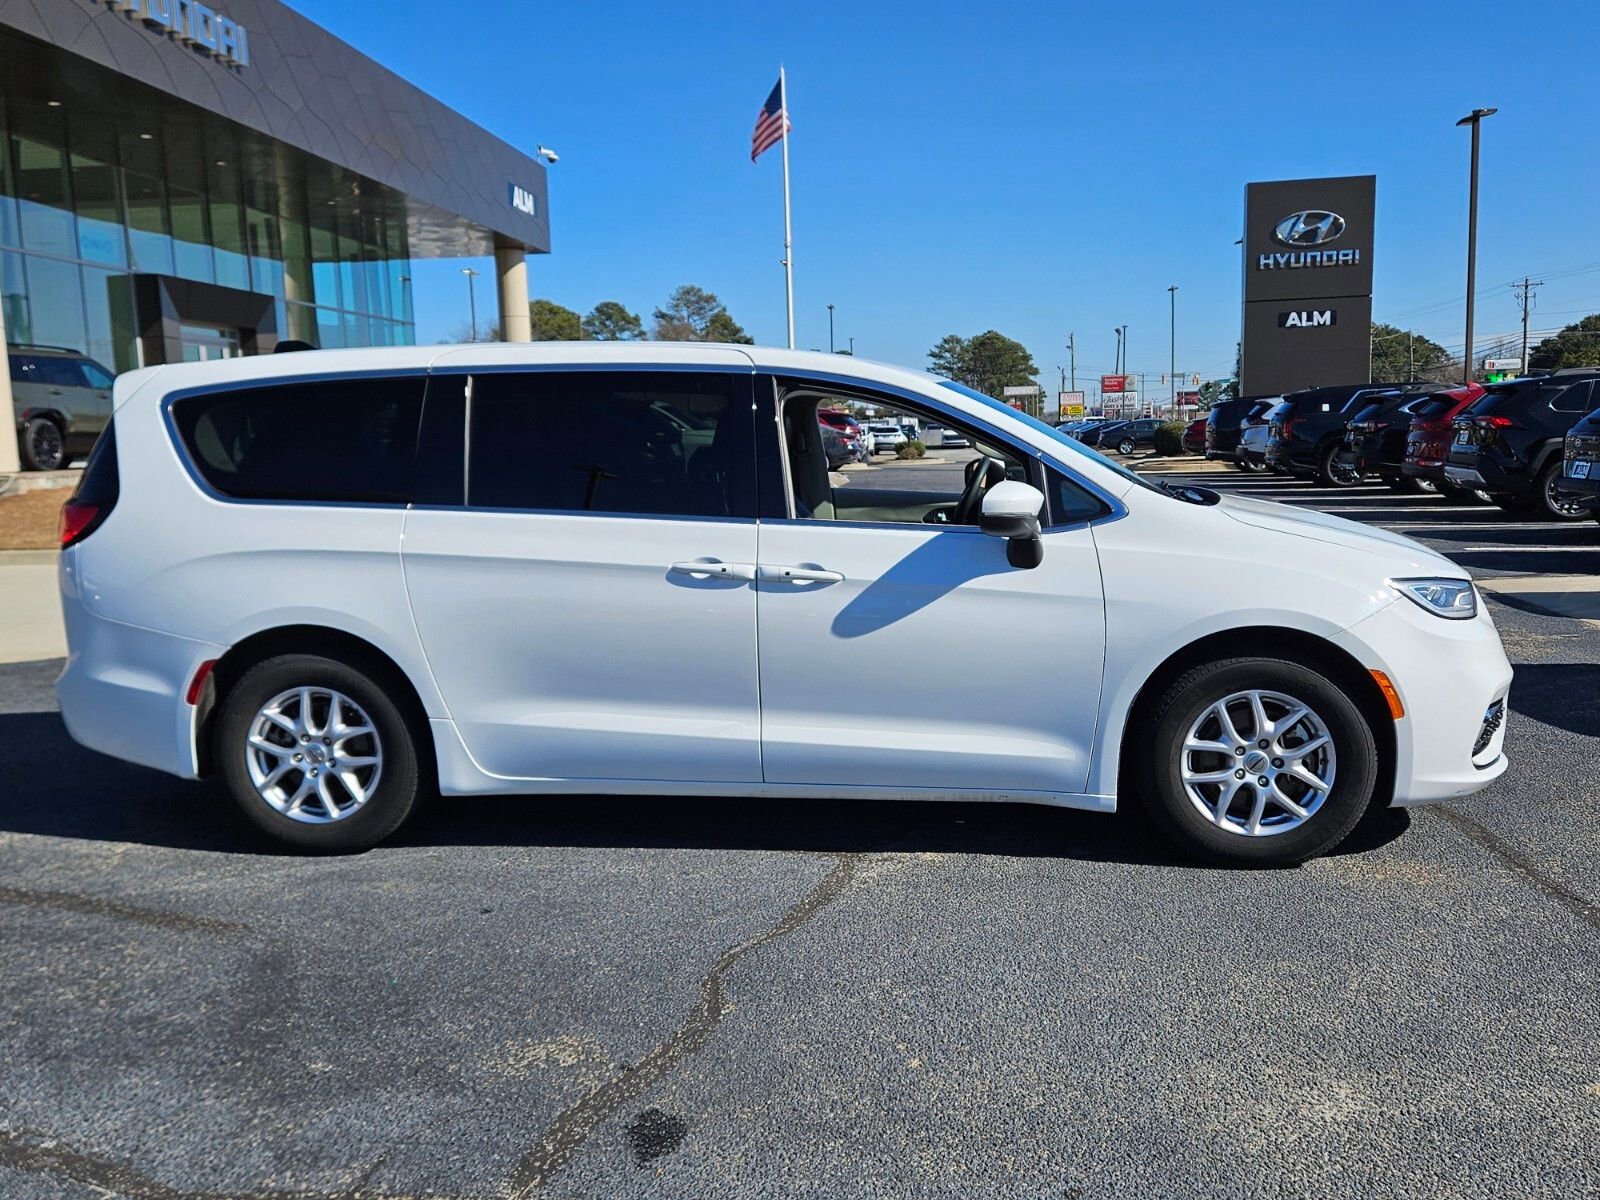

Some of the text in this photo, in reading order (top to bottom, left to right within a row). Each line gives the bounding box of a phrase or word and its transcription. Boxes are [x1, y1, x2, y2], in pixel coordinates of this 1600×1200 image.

[104, 0, 249, 67] UNDAI
[513, 185, 534, 216] ALM
[1259, 249, 1360, 270] HYUNDAI
[1285, 310, 1331, 328] ALM
